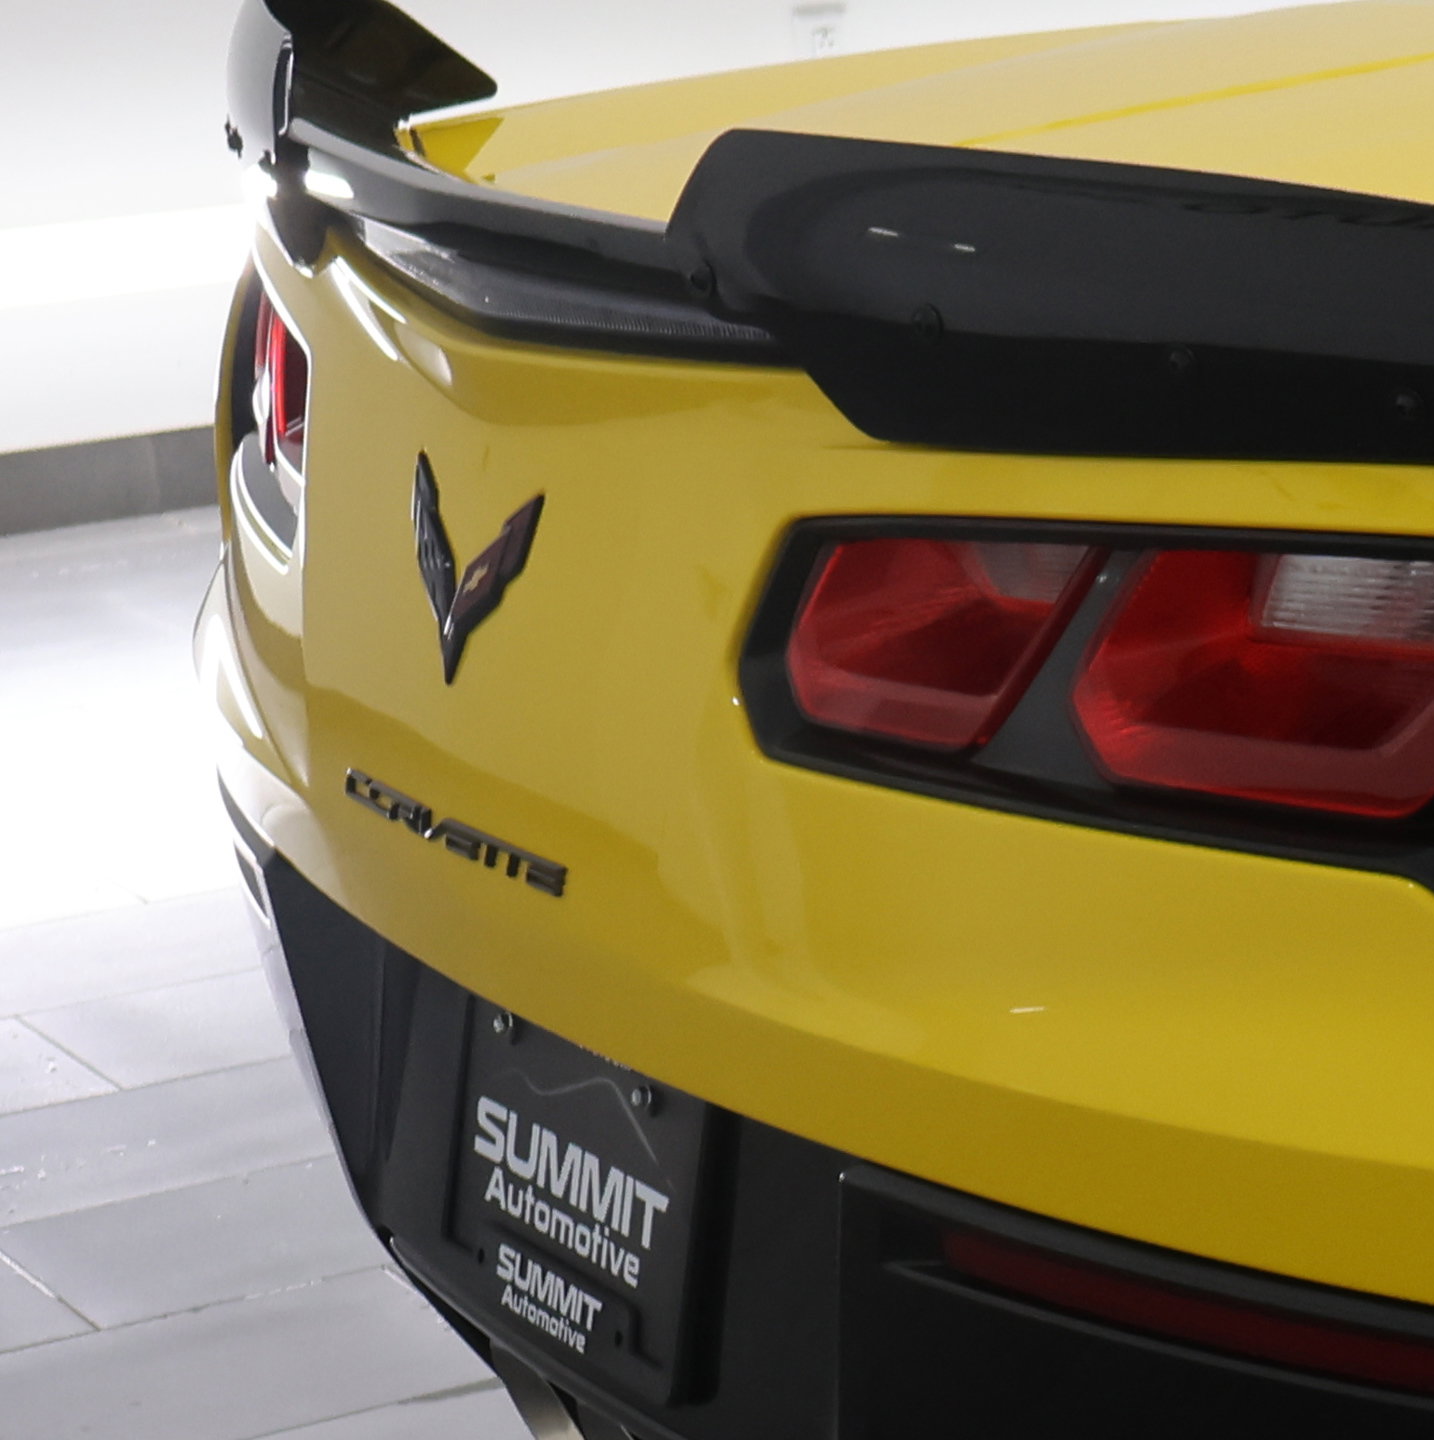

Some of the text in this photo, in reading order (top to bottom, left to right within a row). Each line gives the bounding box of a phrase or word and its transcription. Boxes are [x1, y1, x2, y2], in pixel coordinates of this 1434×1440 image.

[346, 767, 568, 897] CORVETTE
[474, 1096, 669, 1250] SUMMIT
[484, 1166, 640, 1289] Automotive
[496, 1243, 602, 1331] SUMMIT
[501, 1284, 586, 1354] Automotive
